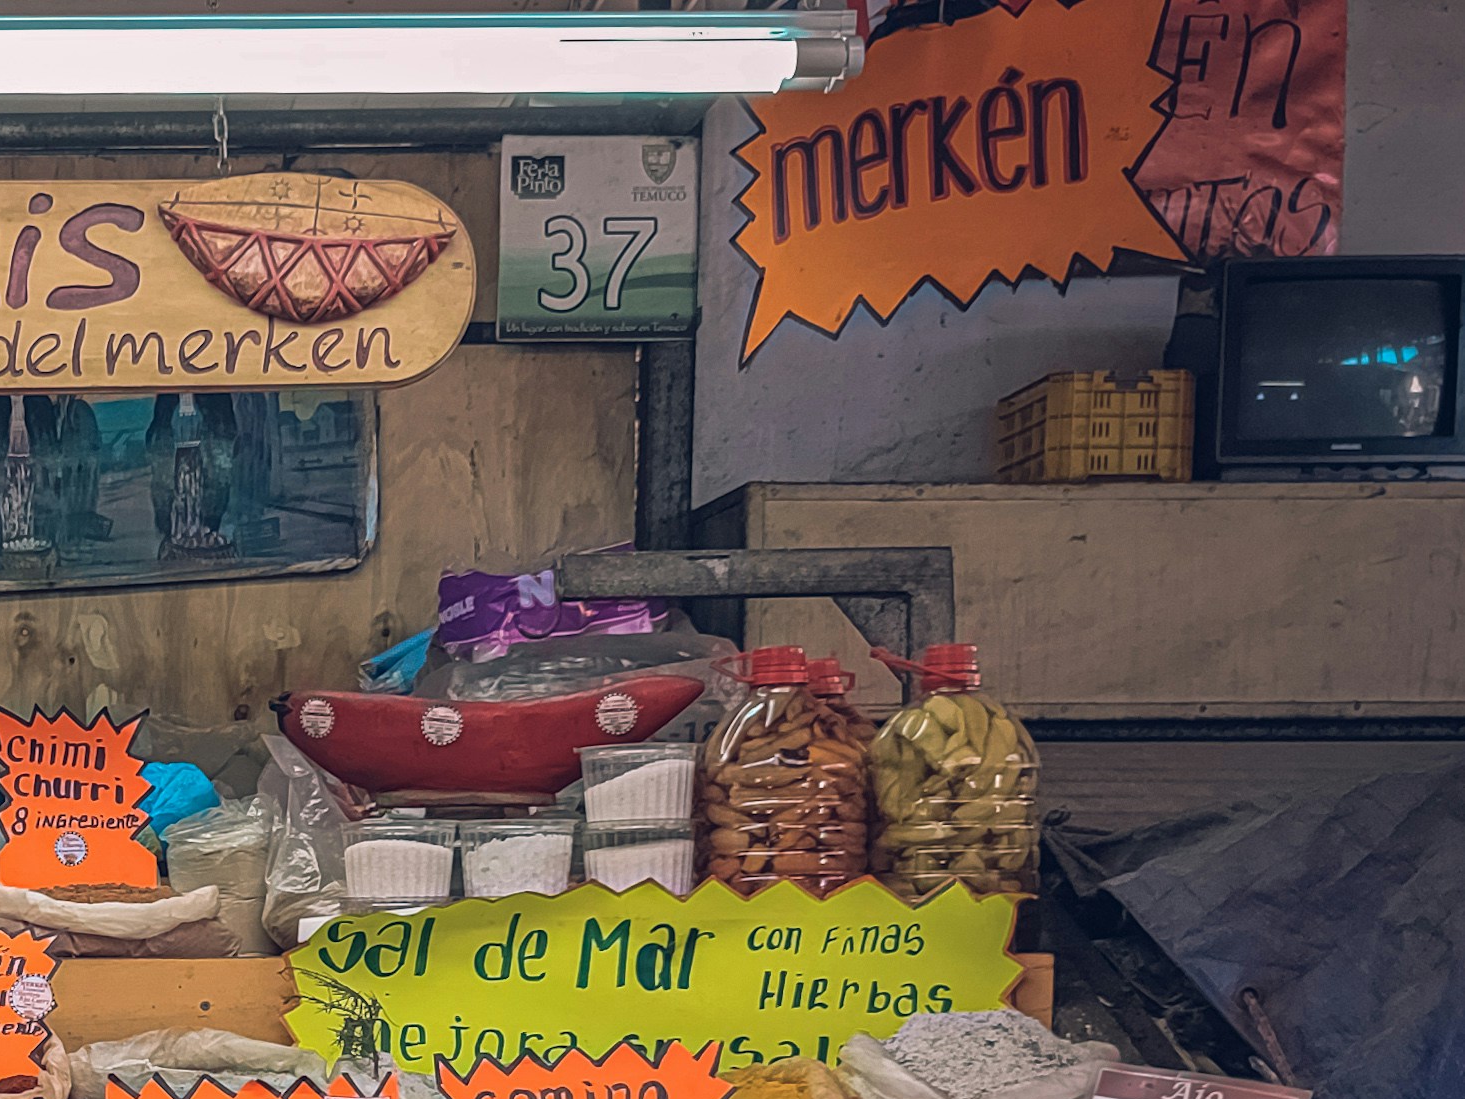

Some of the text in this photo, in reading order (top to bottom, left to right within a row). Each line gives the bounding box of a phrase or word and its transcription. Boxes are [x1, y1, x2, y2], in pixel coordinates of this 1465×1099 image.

[518, 159, 560, 178] Feria
[772, 67, 1088, 244] merkén
[517, 176, 561, 195] Pinto
[631, 191, 687, 202] TEMUCO
[538, 215, 658, 313] 37
[105, 313, 401, 377] merken
[439, 596, 475, 624] NOBLE
[14, 773, 124, 804] Churri
[11, 807, 29, 836] 8
[476, 913, 549, 981] de
[577, 917, 715, 991] Mar
[747, 924, 802, 955] con
